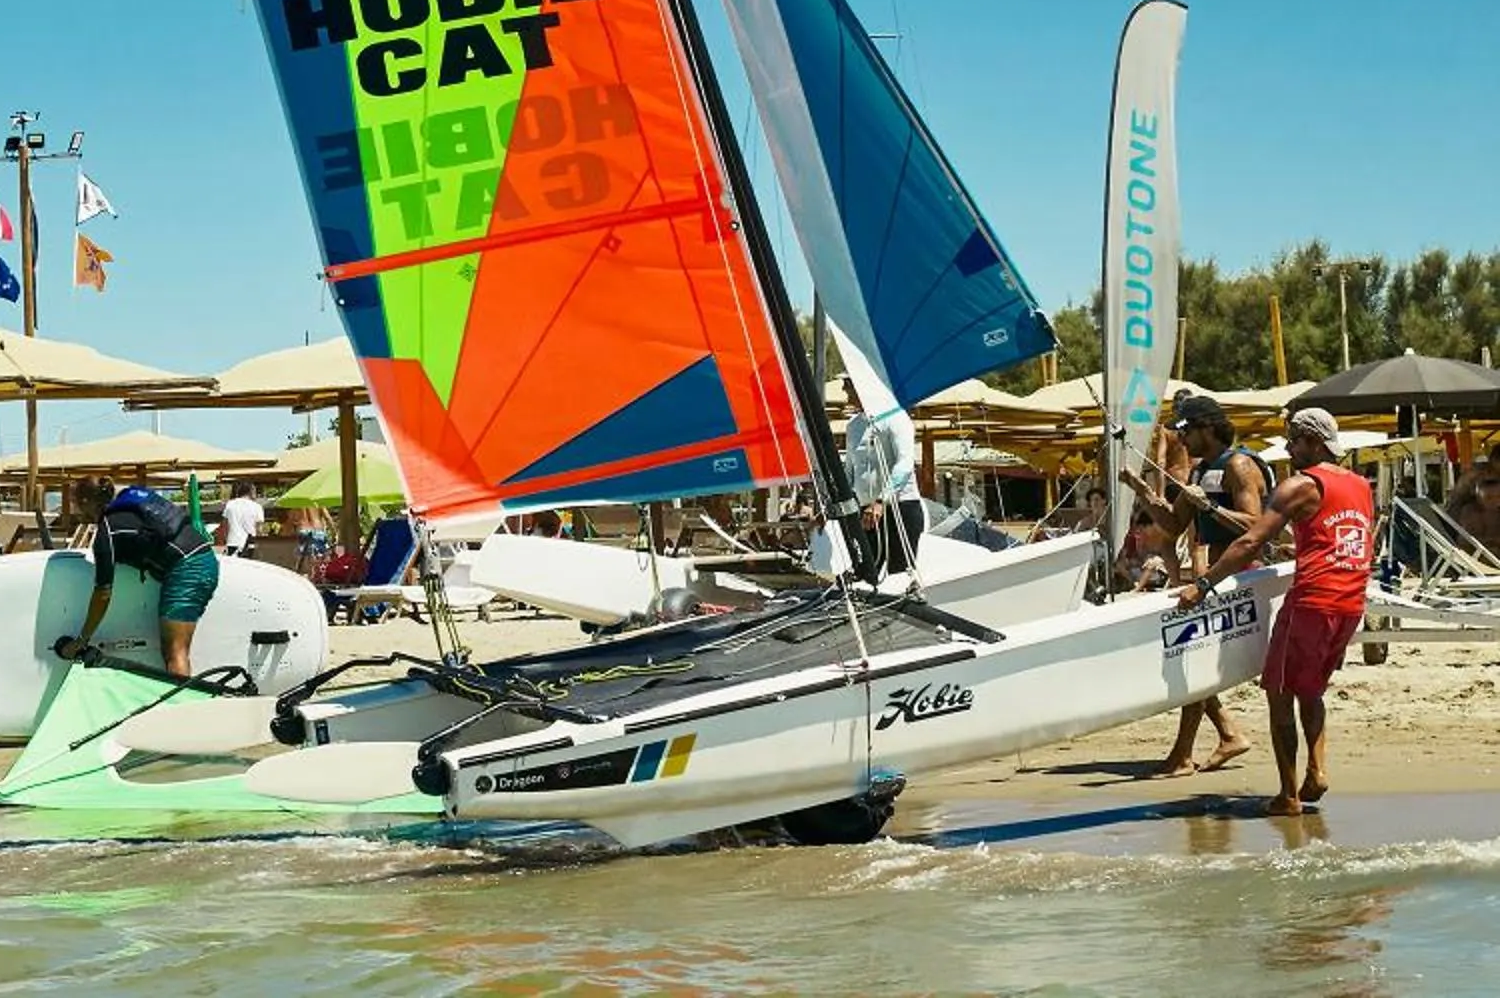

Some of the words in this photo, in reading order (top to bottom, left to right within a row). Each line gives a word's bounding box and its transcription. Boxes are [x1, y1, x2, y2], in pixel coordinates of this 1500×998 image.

[356, 12, 561, 97] CAT
[1124, 108, 1159, 350] DUOTONE
[875, 682, 974, 731] Hobie
